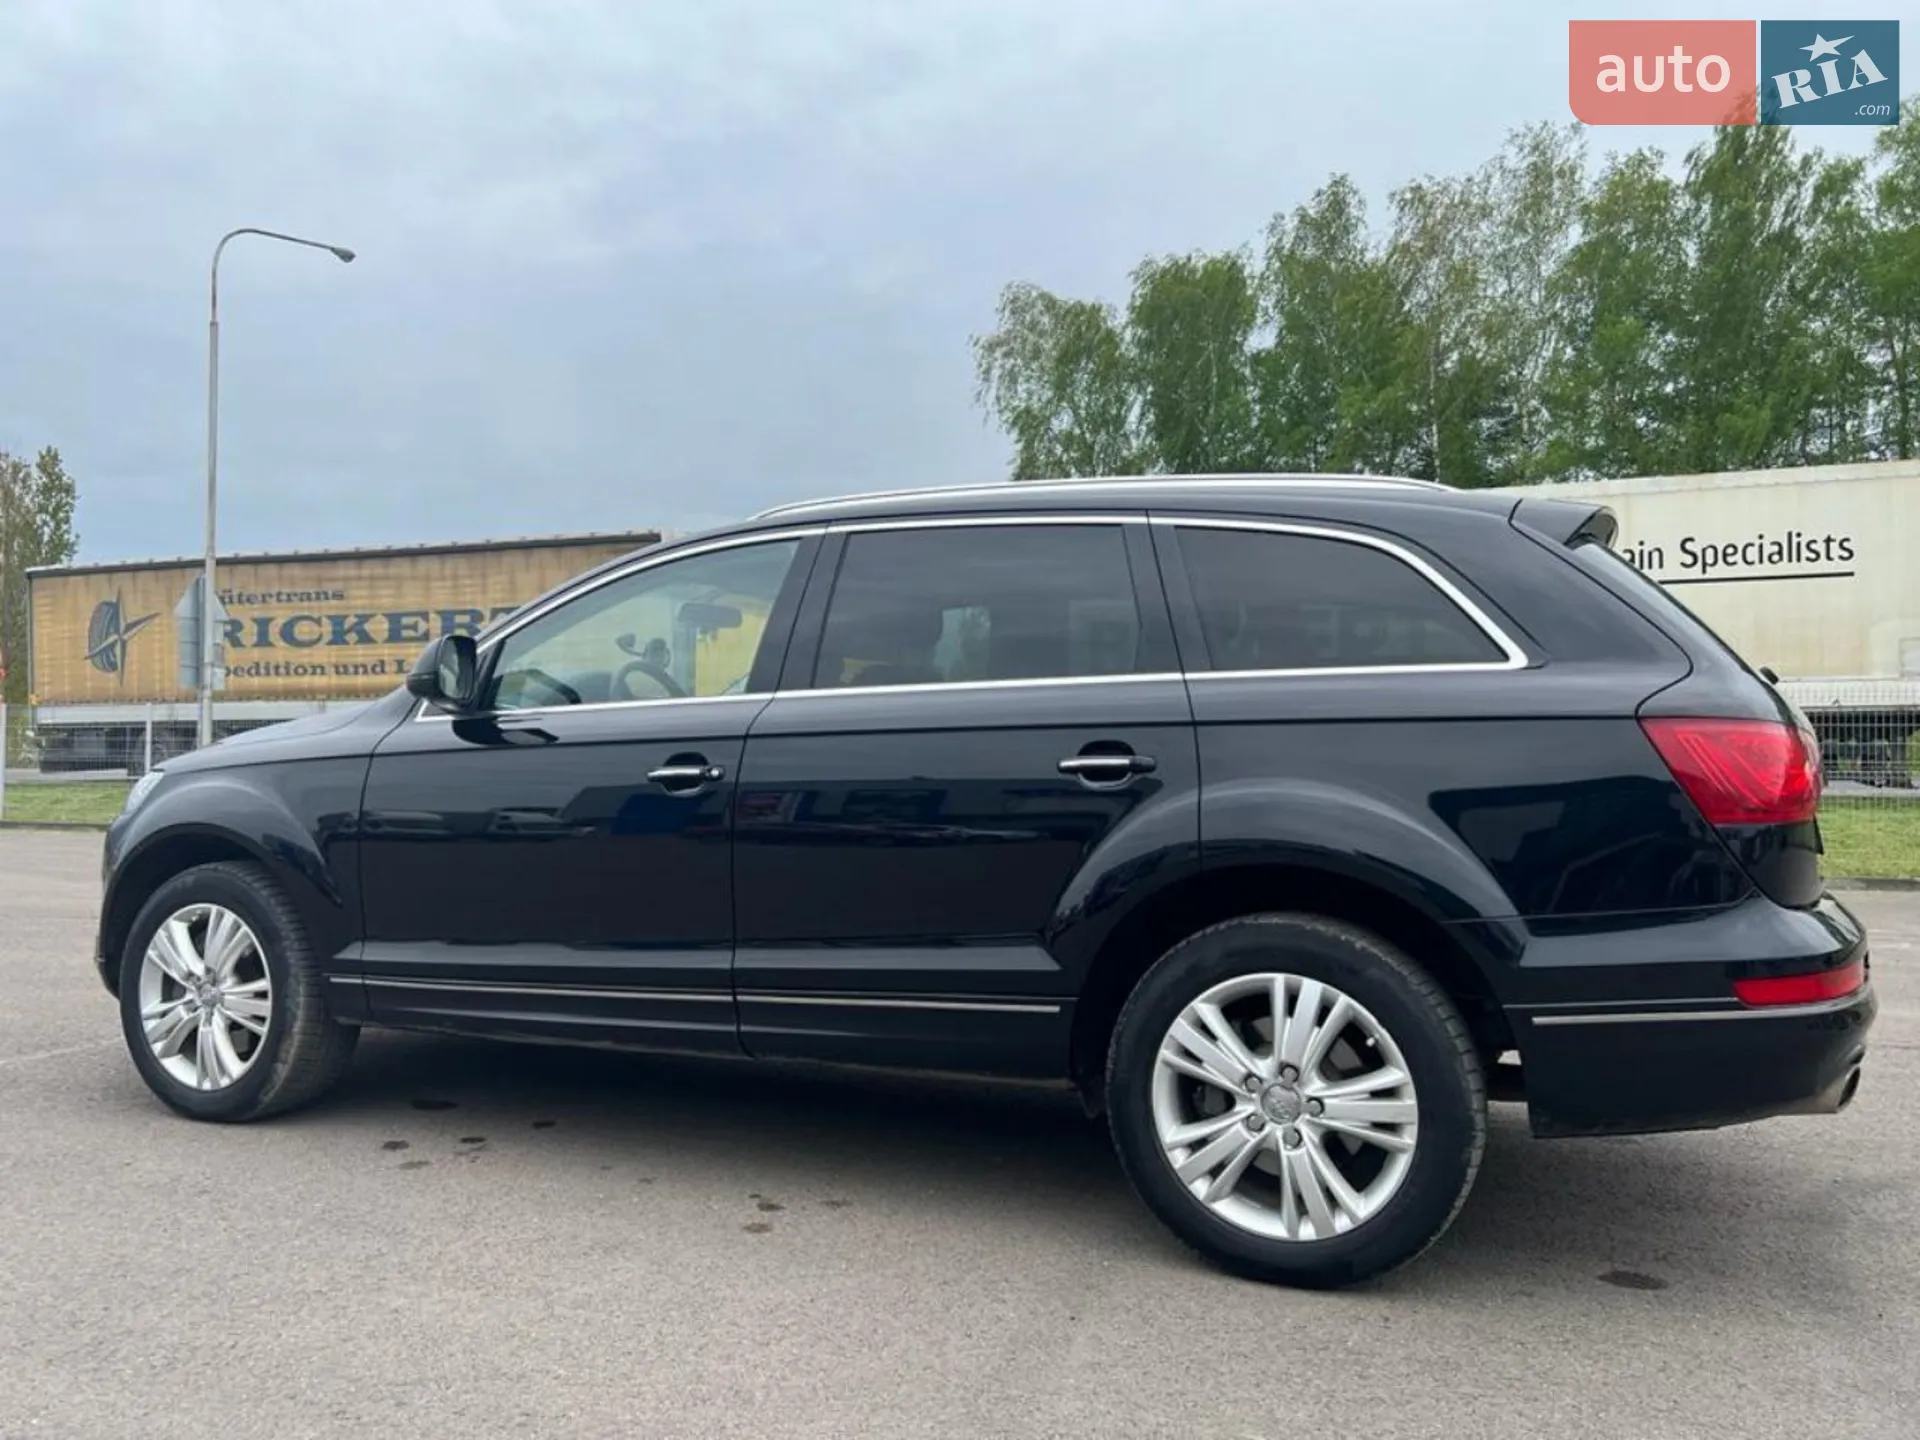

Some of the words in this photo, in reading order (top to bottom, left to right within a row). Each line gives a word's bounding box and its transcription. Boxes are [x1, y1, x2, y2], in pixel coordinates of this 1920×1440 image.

[1679, 531, 1855, 574] Specialists
[223, 607, 519, 648] RICKER
[334, 659, 386, 676] und
